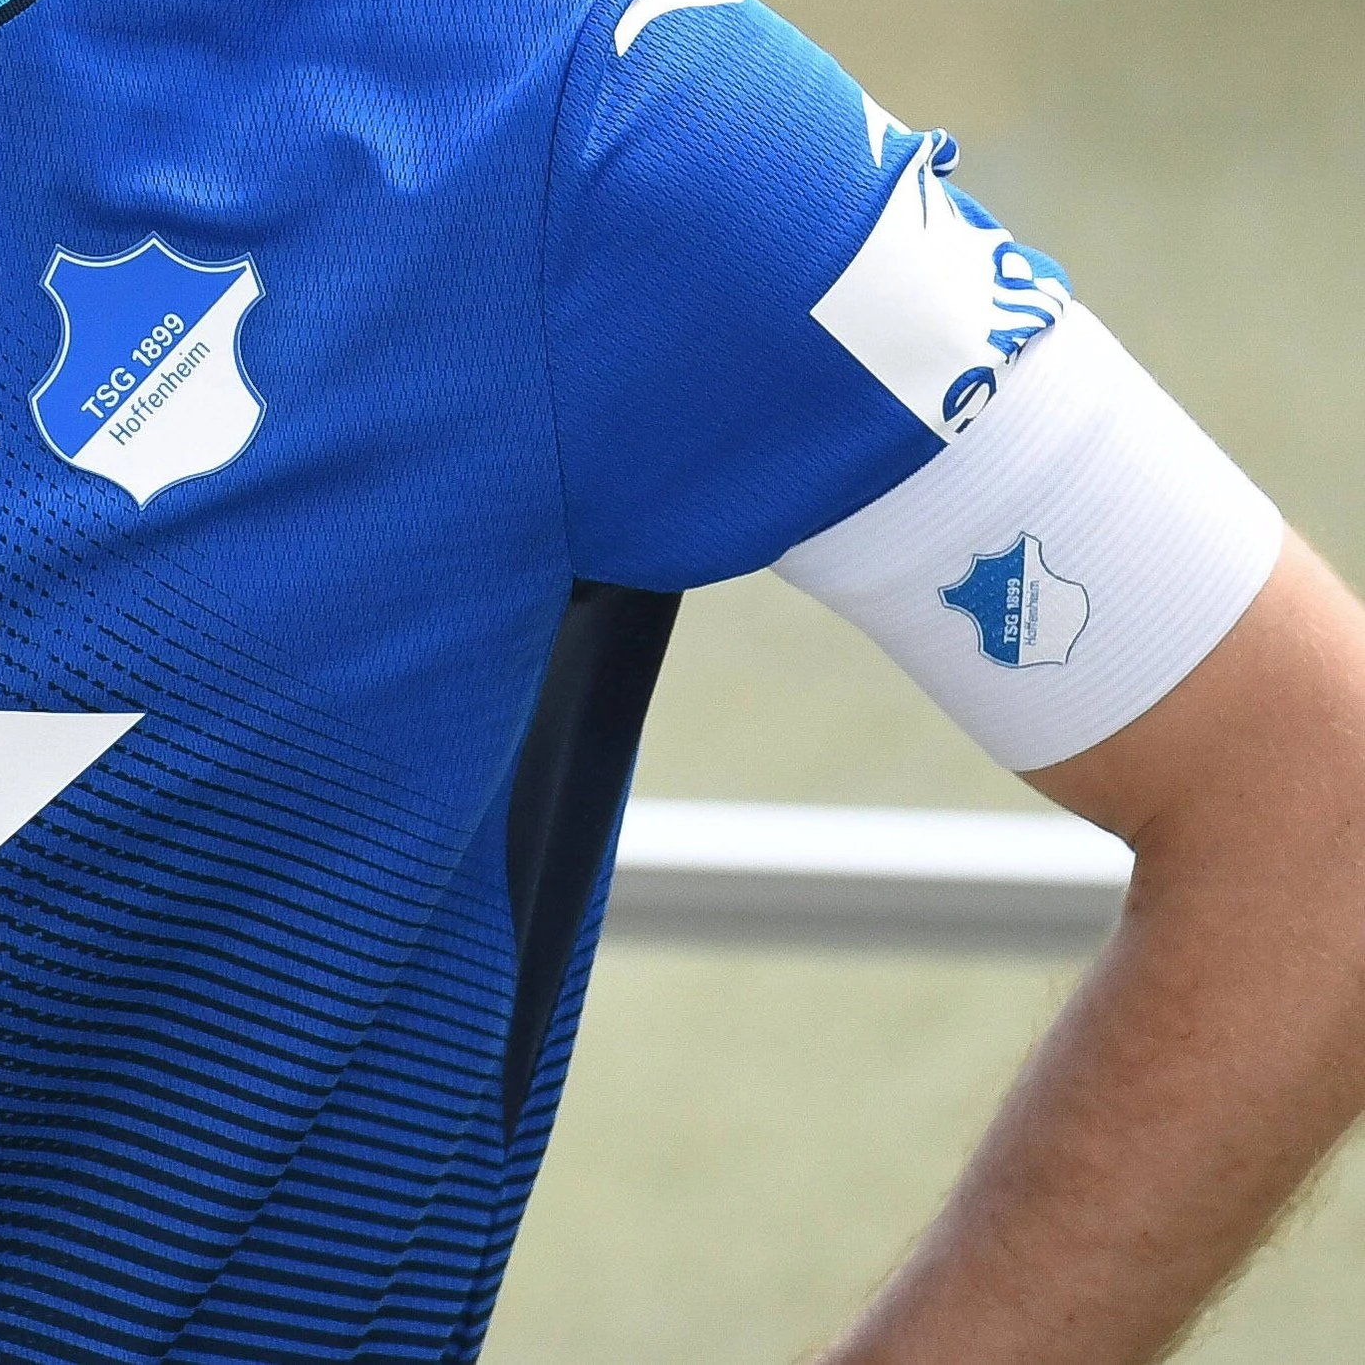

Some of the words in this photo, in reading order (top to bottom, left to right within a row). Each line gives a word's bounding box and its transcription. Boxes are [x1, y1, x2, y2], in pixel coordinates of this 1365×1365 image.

[80, 366, 137, 419] TSG
[131, 312, 185, 367] 1899
[108, 340, 212, 446] Hoffenheim
[1003, 612, 1020, 645] TSG
